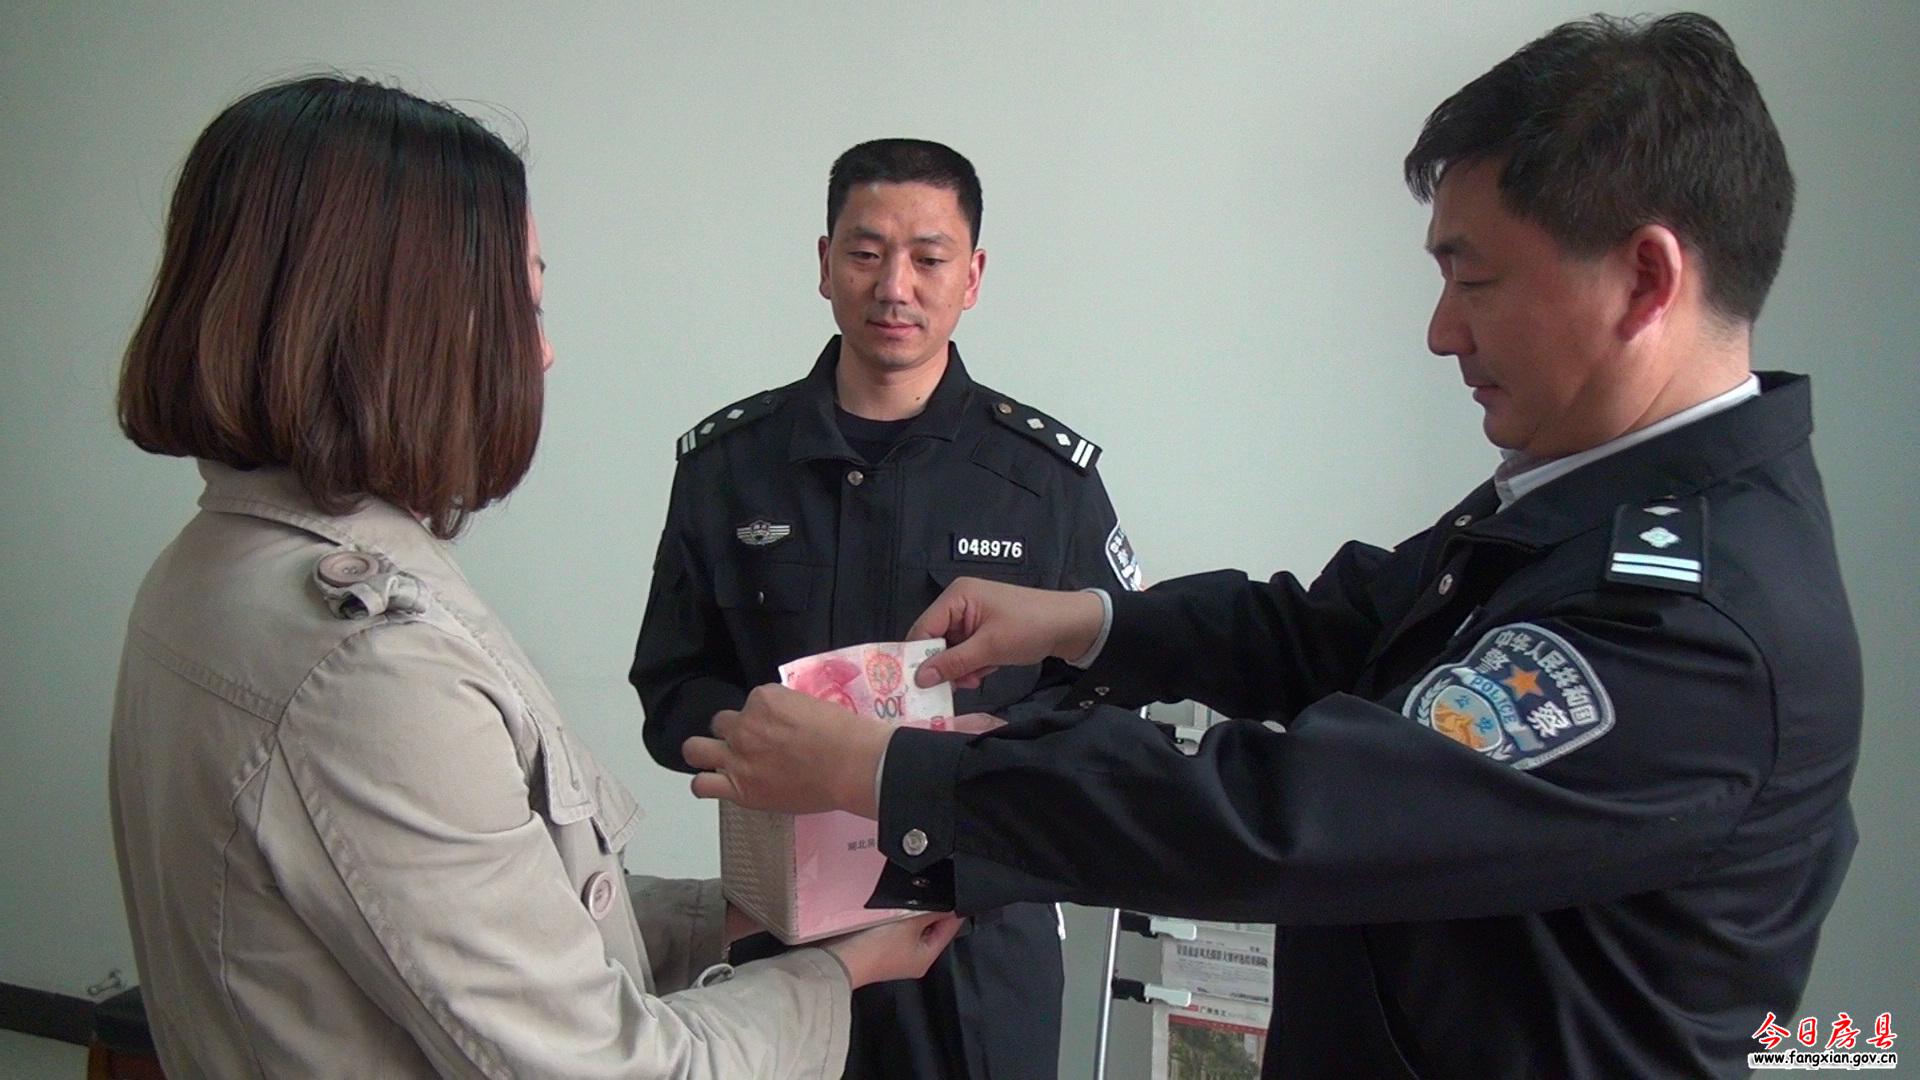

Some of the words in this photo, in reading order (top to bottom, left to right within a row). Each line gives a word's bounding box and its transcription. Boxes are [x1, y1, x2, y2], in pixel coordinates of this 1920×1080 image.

[958, 538, 1022, 558] 048976
[1470, 677, 1517, 726] POLICE
[1495, 630, 1599, 725] 中华人民共和国
